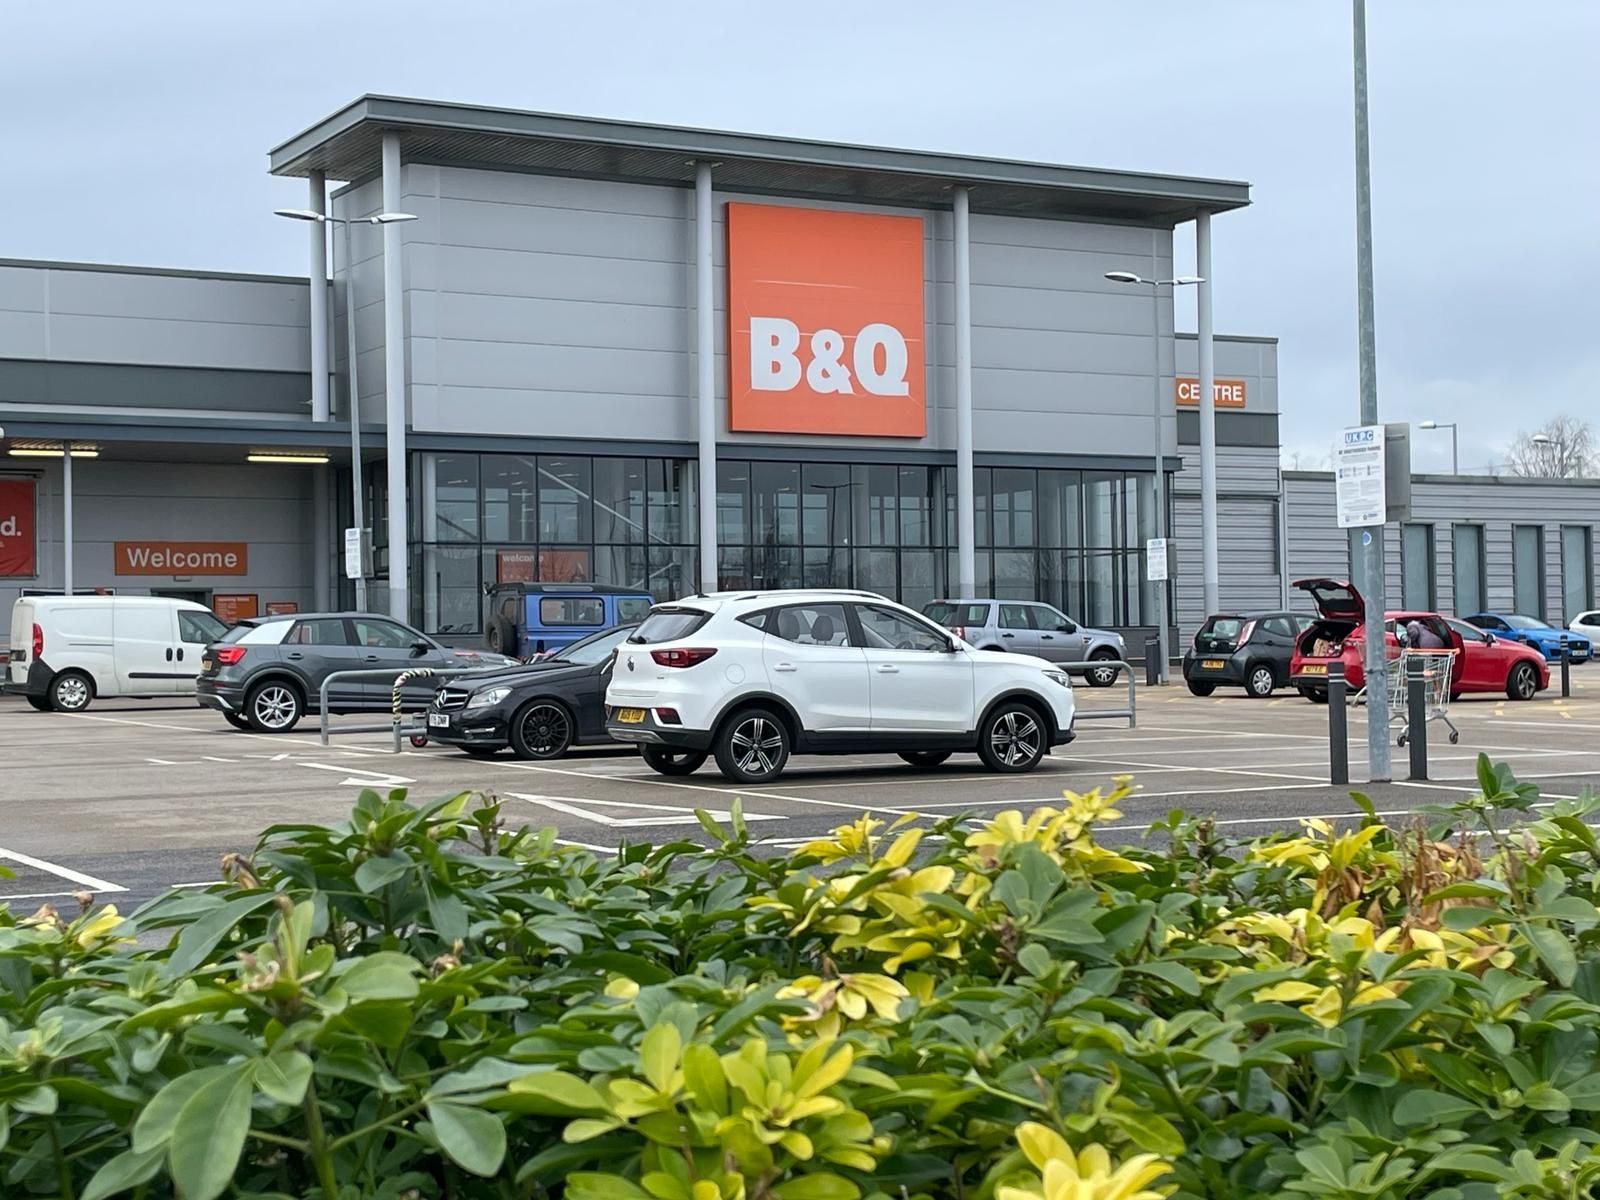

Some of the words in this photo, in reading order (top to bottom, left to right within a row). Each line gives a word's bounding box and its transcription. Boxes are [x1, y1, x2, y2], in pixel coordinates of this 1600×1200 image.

[750, 316, 909, 396] B&Q
[1178, 383, 1243, 401] CETRE
[1345, 430, 1374, 444] UKPC
[127, 547, 238, 568] Welcome
